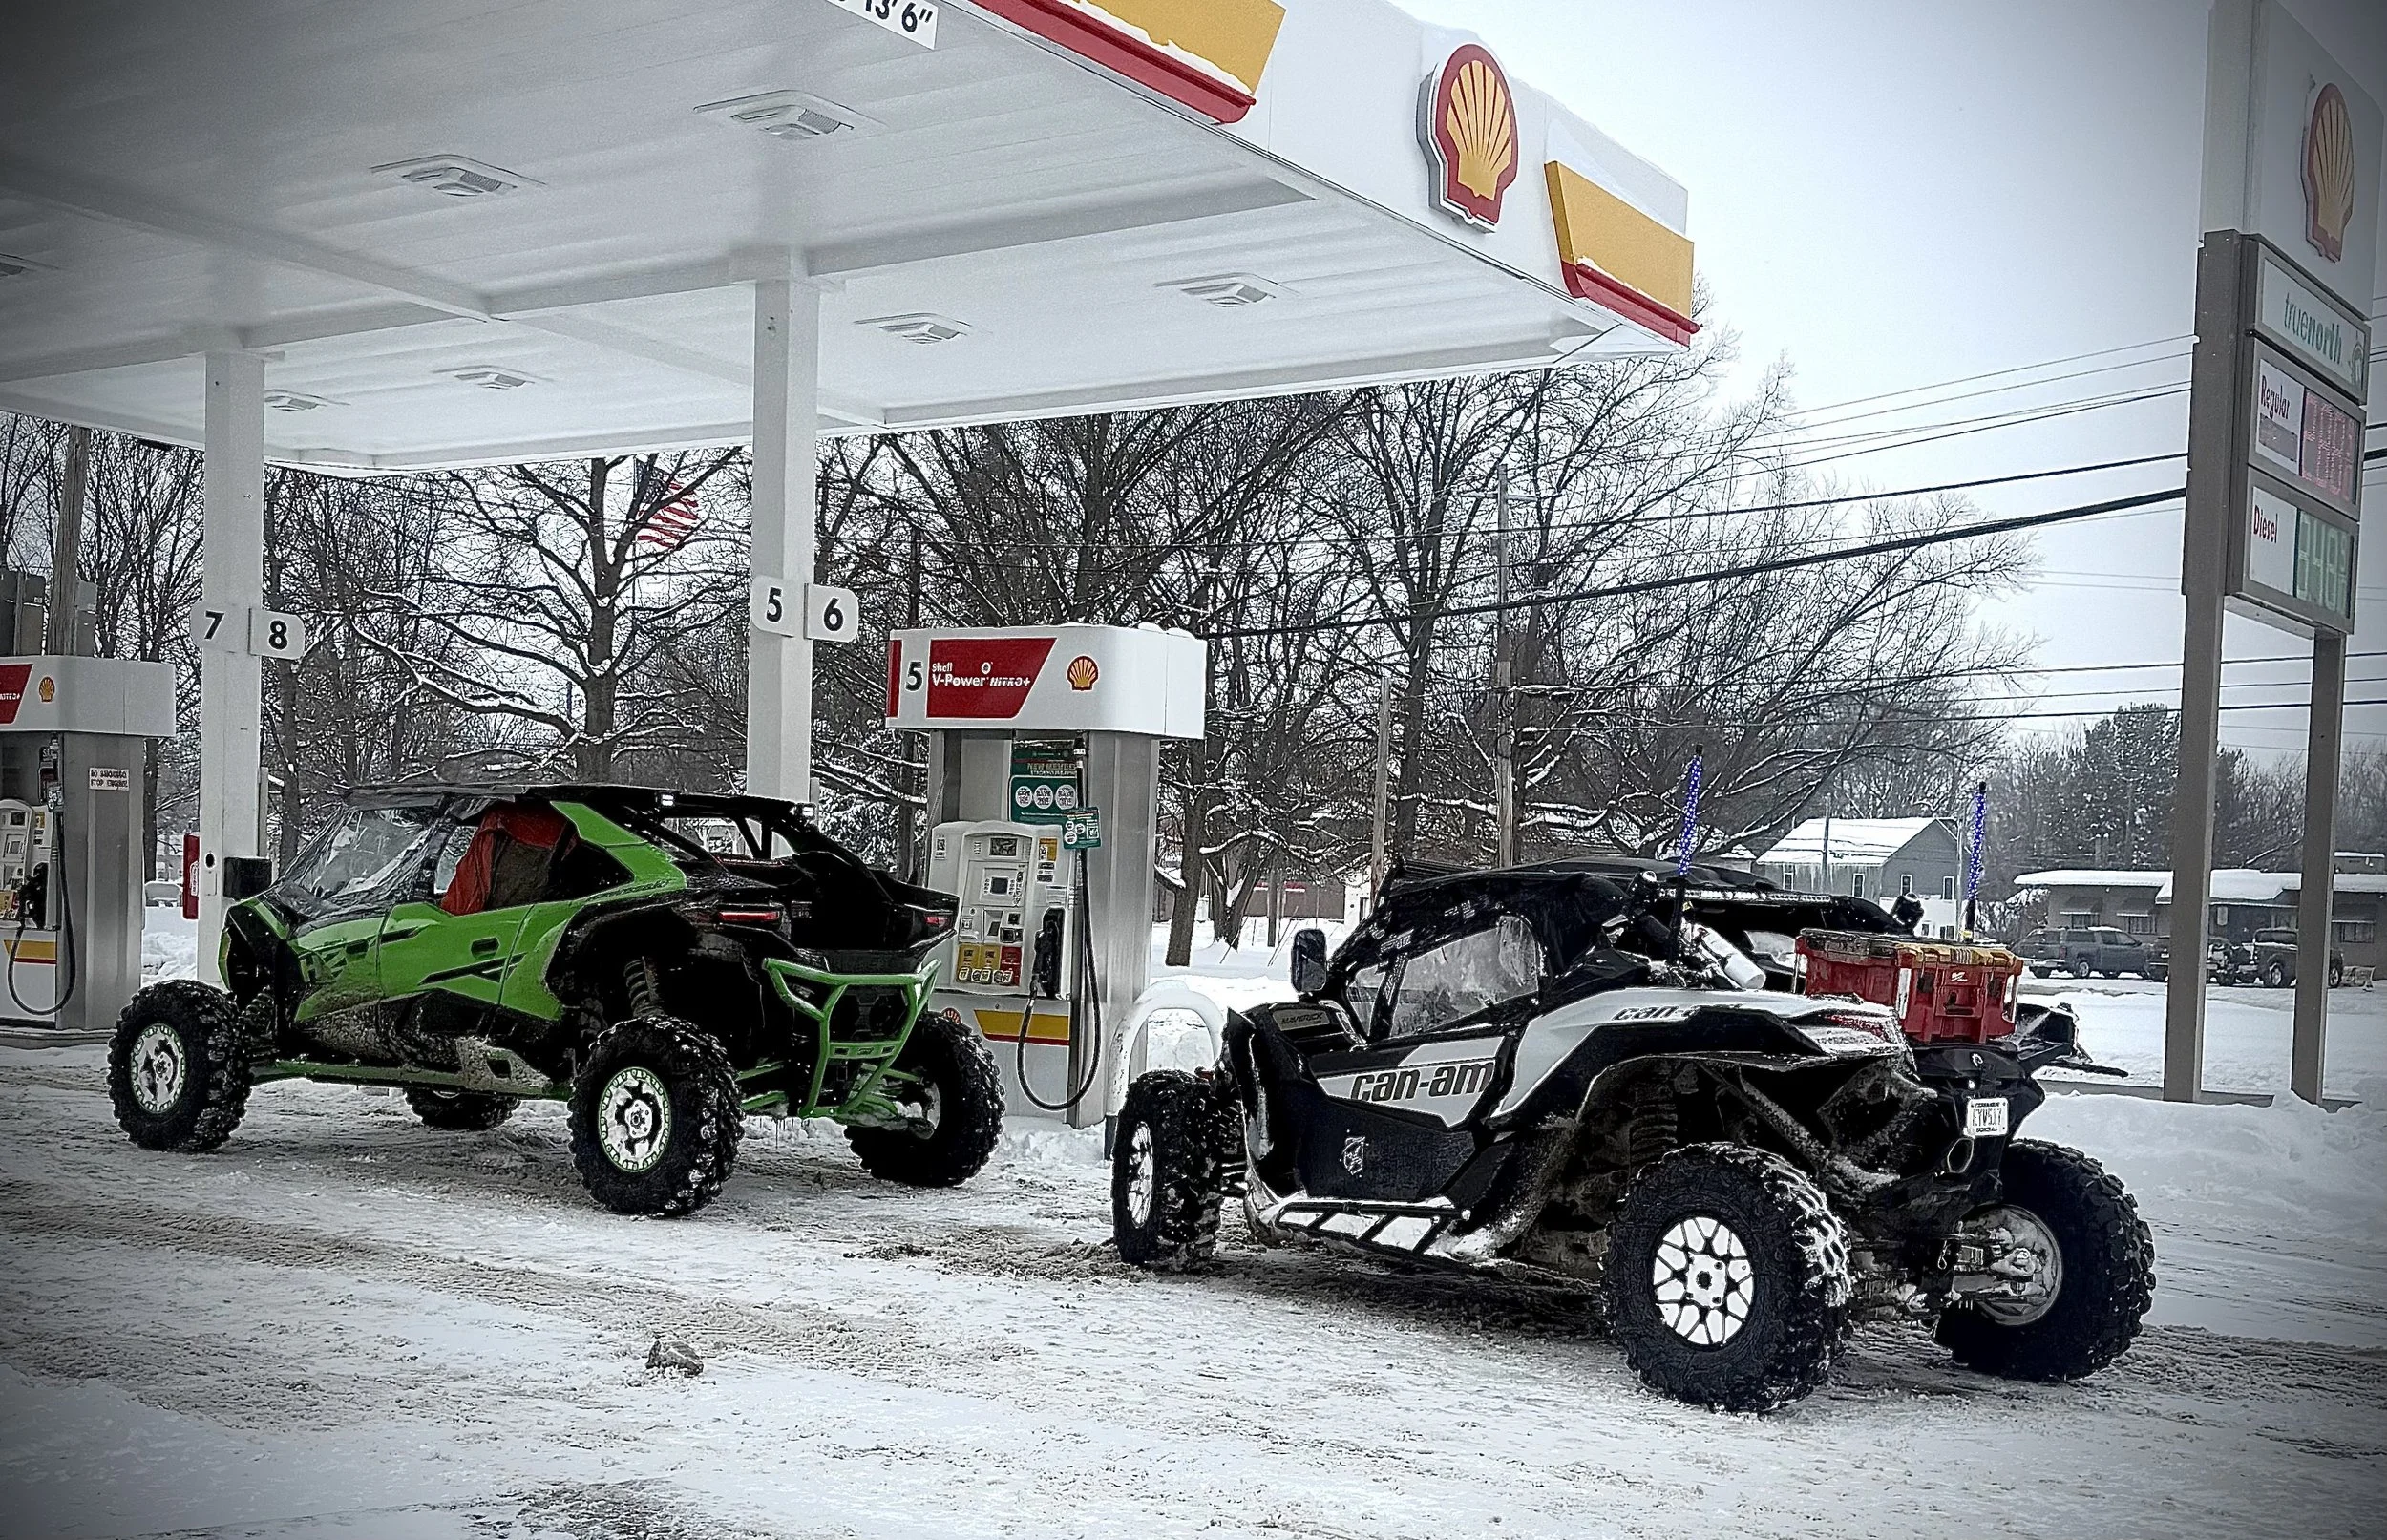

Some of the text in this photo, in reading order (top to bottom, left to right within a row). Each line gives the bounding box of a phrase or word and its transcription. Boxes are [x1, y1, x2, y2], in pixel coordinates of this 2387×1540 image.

[2284, 292, 2342, 365] truenorth
[2260, 375, 2290, 419] Regular
[2253, 504, 2278, 543] Diesel
[766, 586, 783, 623] 5
[823, 597, 844, 632] 6
[203, 610, 225, 640] 7
[268, 620, 288, 650] 8
[904, 661, 923, 691] 5
[931, 662, 953, 673] Shell
[931, 673, 986, 686] V-Power
[1350, 1061, 1495, 1103] can-am
